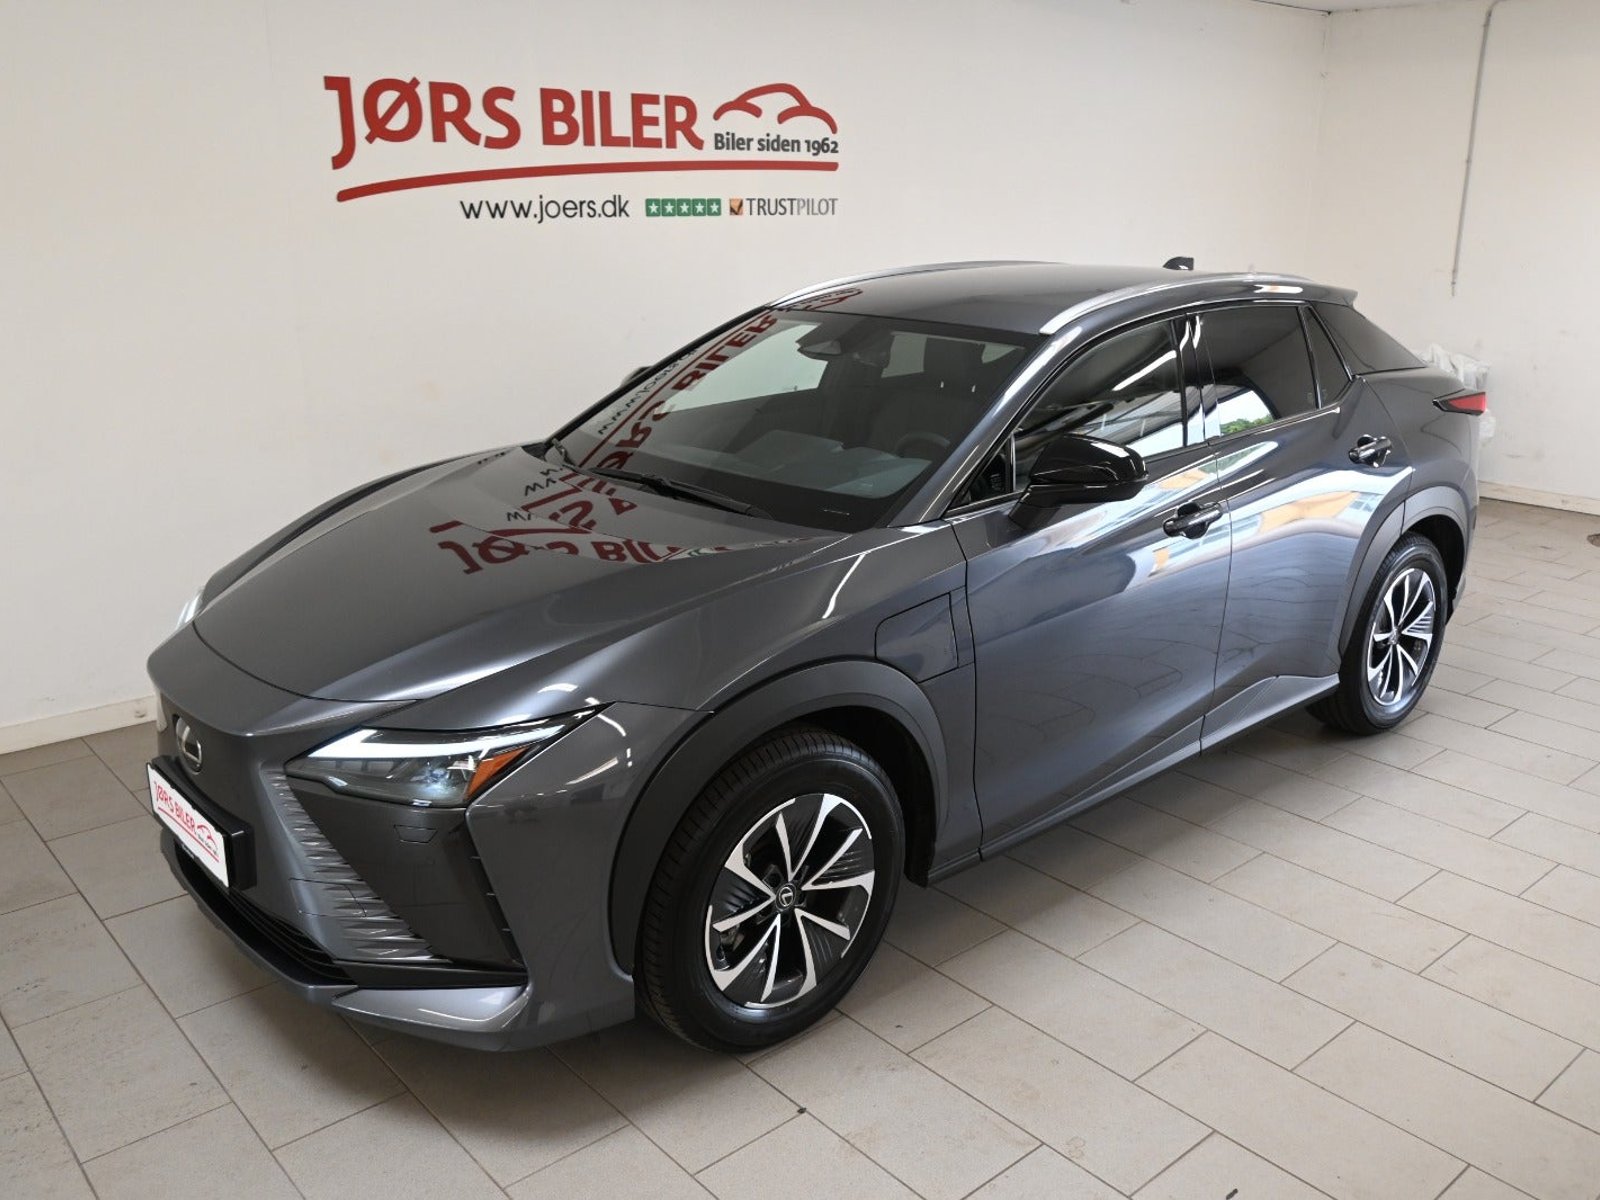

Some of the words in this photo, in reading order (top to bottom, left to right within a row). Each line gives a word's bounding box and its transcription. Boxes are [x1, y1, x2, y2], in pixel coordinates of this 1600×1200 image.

[324, 75, 522, 170] JØRS
[539, 87, 705, 150] BILER
[713, 131, 754, 152] Biler
[757, 132, 801, 153] siden
[804, 136, 839, 157] 1962
[459, 194, 630, 225] www.joers.dk
[745, 197, 839, 216] TRUSTPILOT
